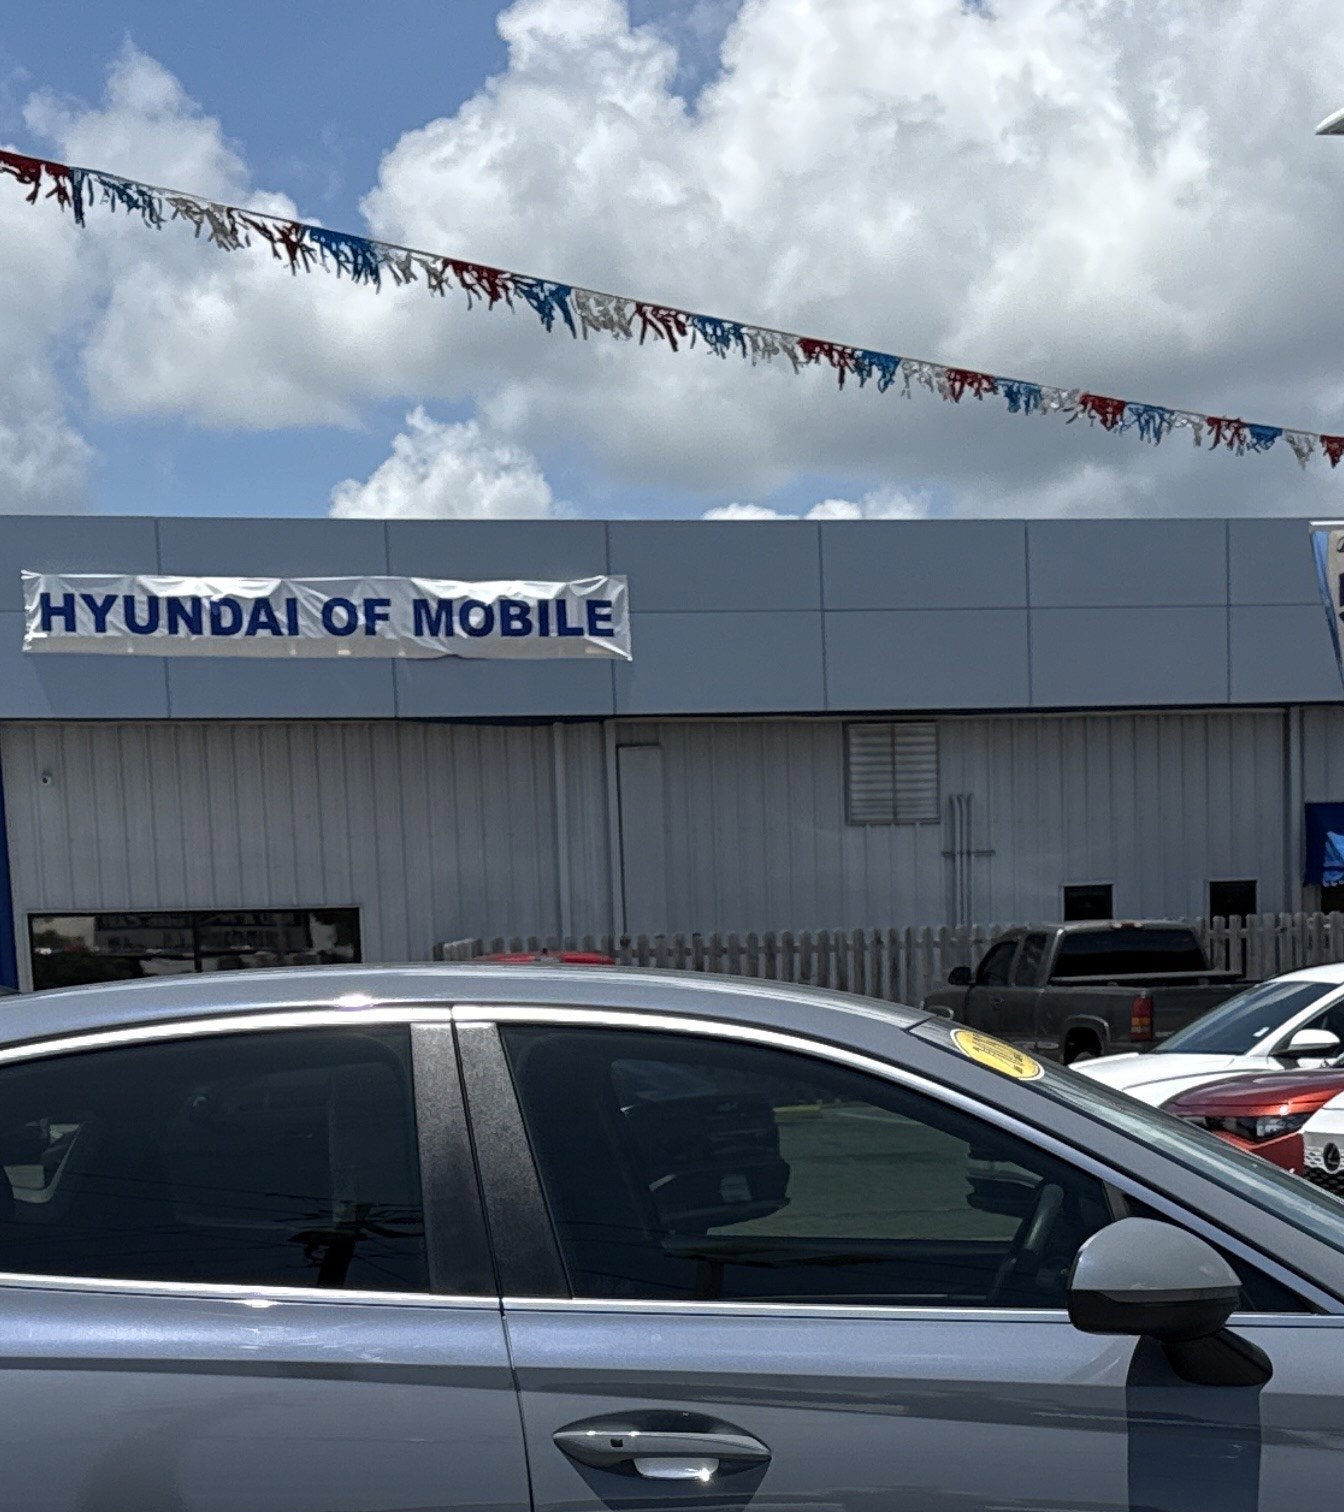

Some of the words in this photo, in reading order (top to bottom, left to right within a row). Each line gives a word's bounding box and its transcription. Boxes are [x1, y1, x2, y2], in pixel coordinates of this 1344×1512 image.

[39, 593, 300, 637] HYUNDAI
[321, 594, 391, 637] OF
[411, 597, 615, 638] MOBILE
